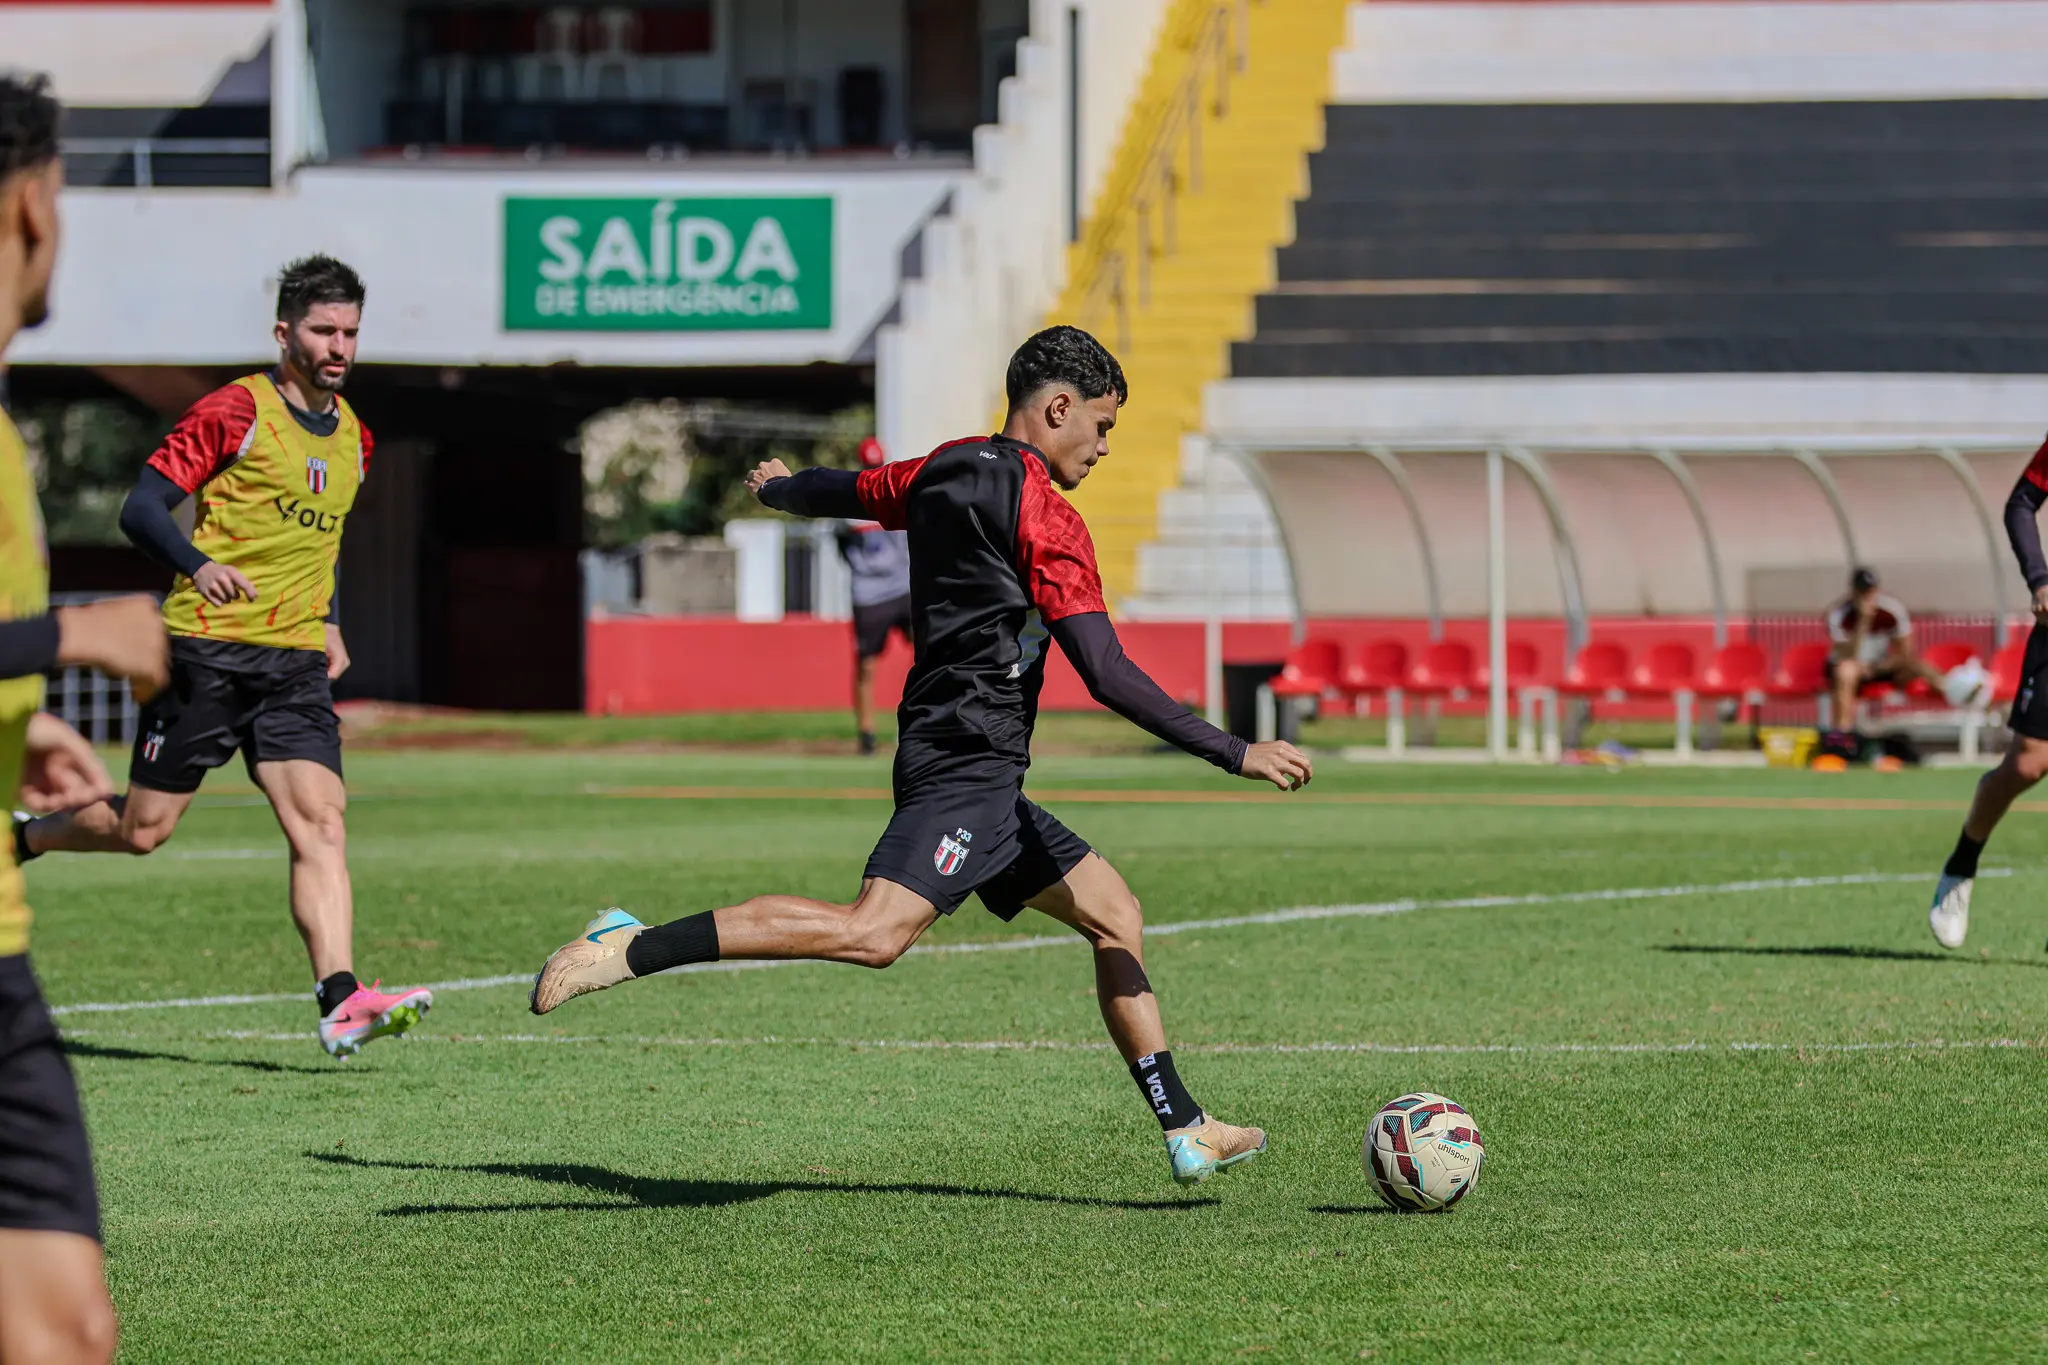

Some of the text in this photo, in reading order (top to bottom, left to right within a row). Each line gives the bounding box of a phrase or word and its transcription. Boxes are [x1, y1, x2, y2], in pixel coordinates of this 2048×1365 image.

[539, 199, 800, 282] SAÍDA
[536, 284, 580, 316] DE
[274, 498, 339, 533] VOLT
[1146, 1072, 1173, 1115] VOLT
[1438, 1143, 1470, 1165] uhlsport
